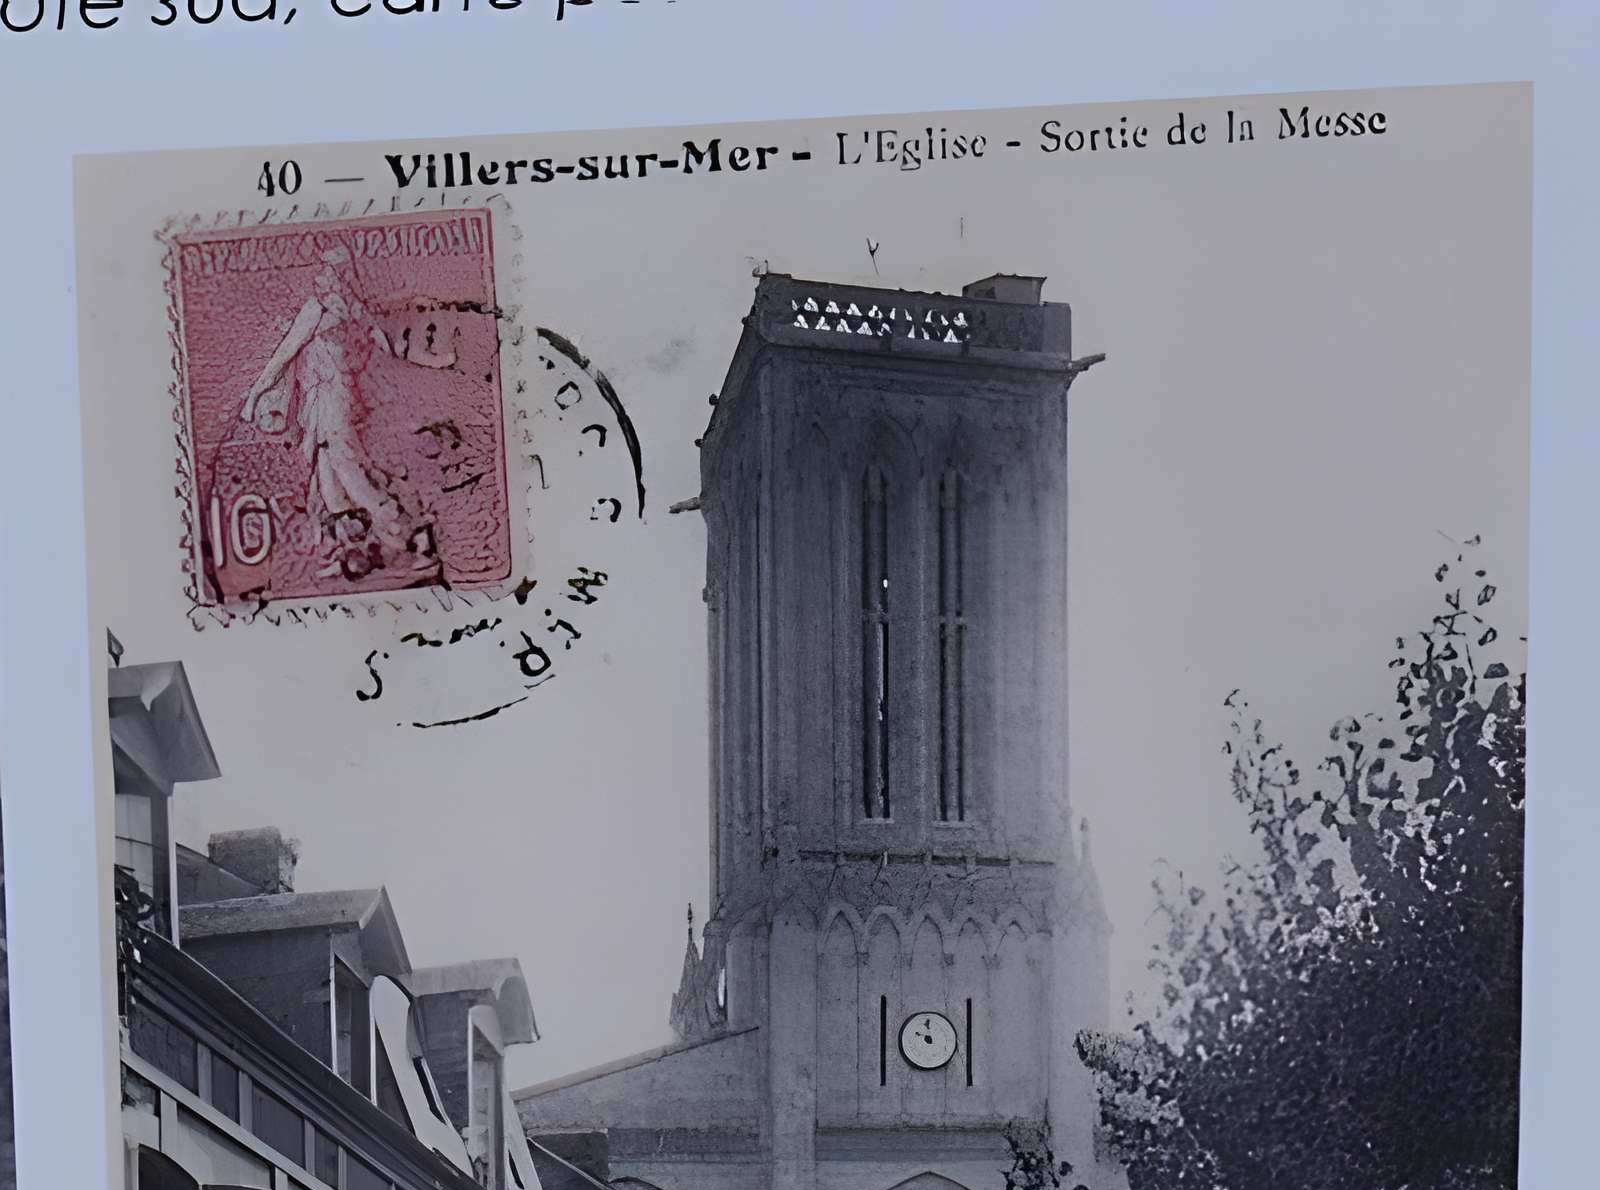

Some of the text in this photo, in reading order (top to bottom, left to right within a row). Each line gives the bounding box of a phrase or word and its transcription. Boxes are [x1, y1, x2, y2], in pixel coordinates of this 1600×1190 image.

[257, 159, 303, 196] 40
[385, 138, 779, 188] Villers-sur-Mer
[837, 127, 987, 171] L'Eglise
[1040, 116, 1148, 152] Sortie
[1167, 112, 1207, 145] de
[1278, 107, 1387, 139] Messe
